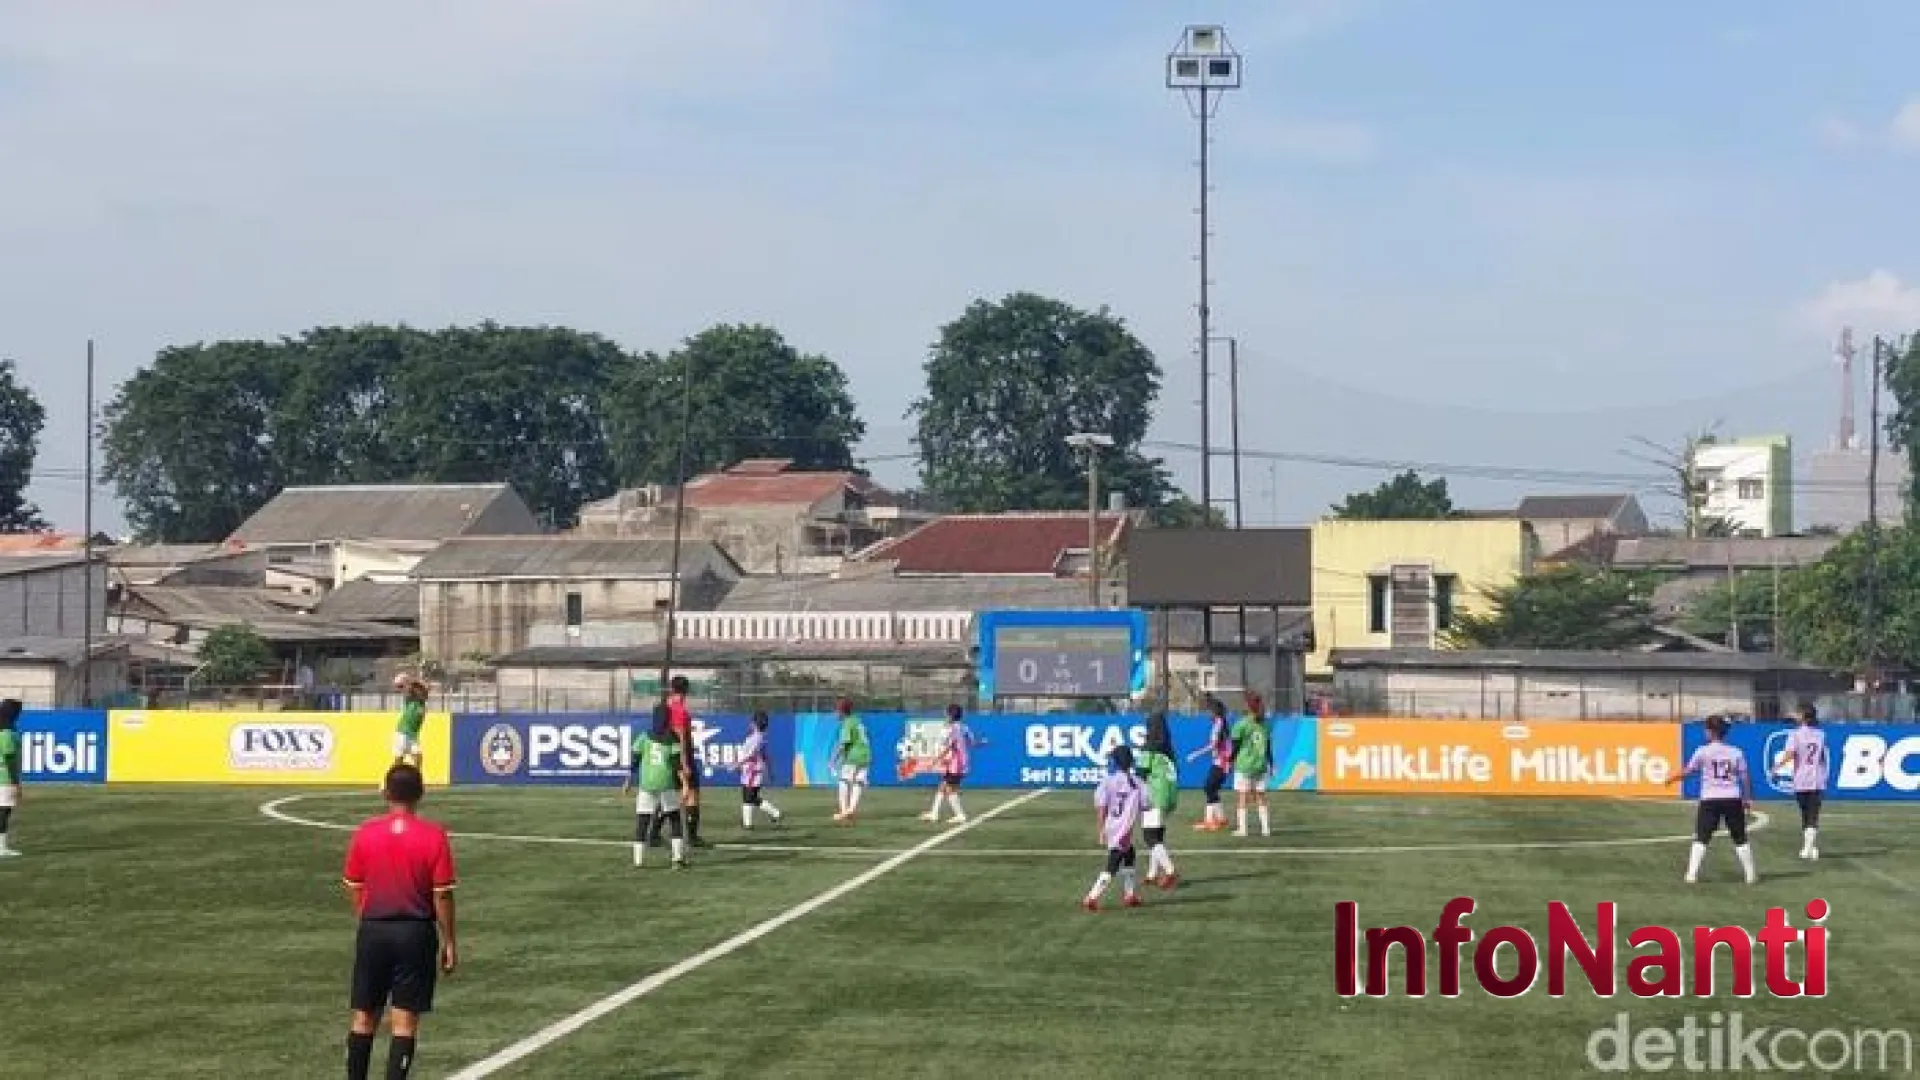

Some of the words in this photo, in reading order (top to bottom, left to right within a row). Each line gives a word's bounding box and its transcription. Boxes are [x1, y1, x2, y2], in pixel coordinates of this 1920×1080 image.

[1019, 658, 1038, 684] 0
[1089, 660, 1103, 683] 1
[529, 725, 632, 766] PSSI
[1021, 767, 1051, 782] Seri
[1055, 767, 1065, 782] 2
[1335, 745, 1492, 782] MilkLife
[1511, 748, 1671, 784] MilkLife
